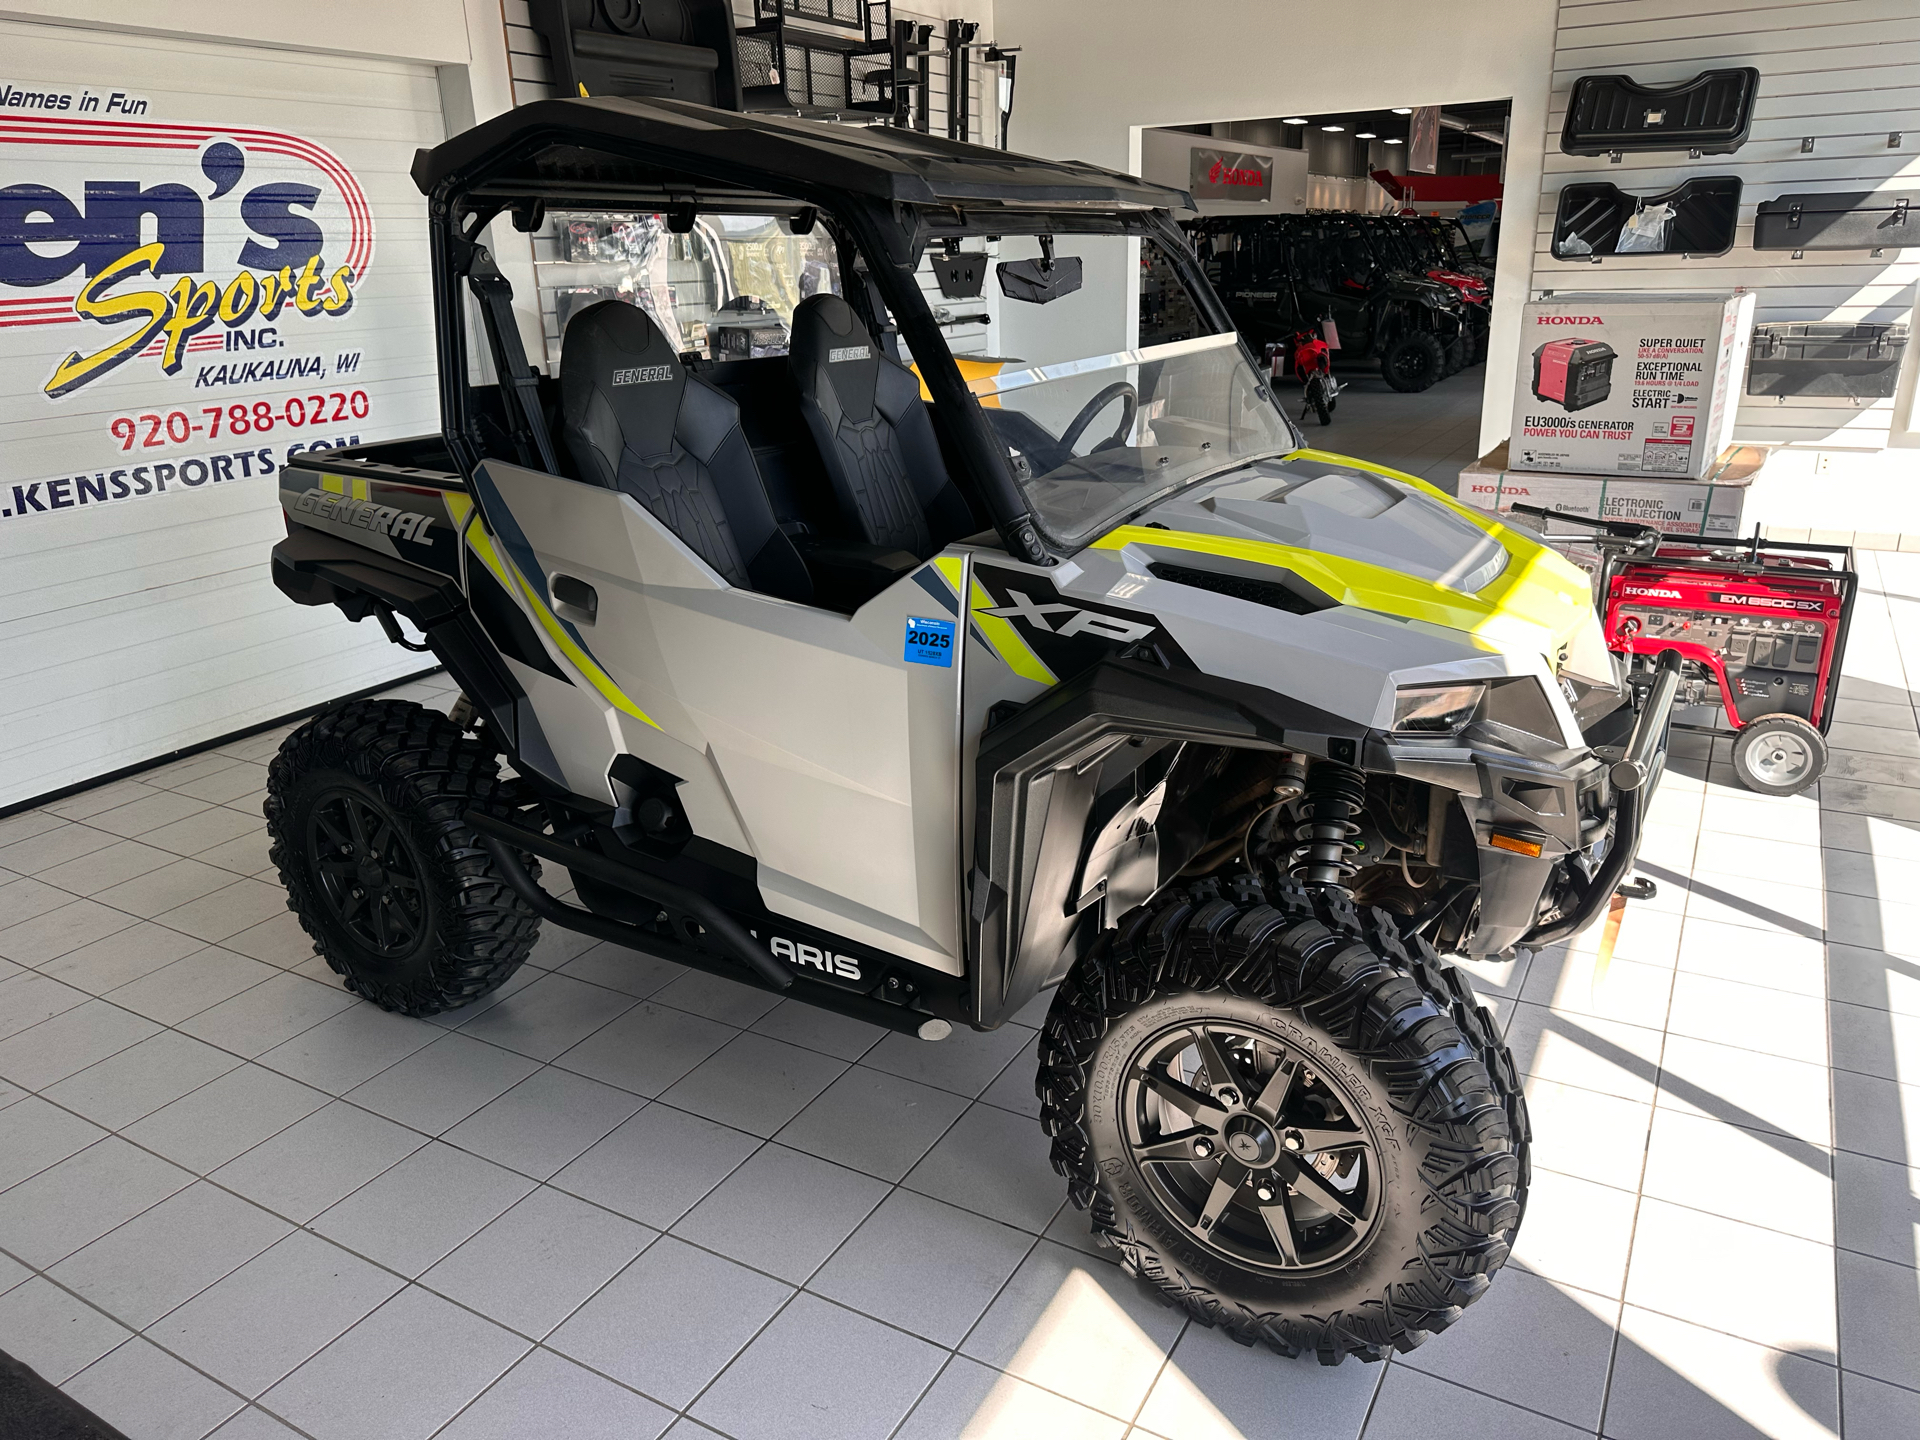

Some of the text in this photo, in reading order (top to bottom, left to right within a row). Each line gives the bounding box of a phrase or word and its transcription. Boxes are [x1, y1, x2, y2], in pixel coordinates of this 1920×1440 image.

[78, 90, 100, 112] in
[105, 92, 148, 115] Fun
[1222, 167, 1264, 187] HONDA
[44, 242, 356, 398] Sports
[1536, 316, 1605, 325] HONDA
[225, 329, 285, 352] INC.
[1639, 338, 1706, 348] SUPER QUIET
[829, 345, 872, 364] GENERAL
[194, 352, 361, 389] KAUKAUNA, WI
[612, 365, 674, 387] GENERAL
[1635, 371, 1685, 381] RUN TIME
[1637, 362, 1703, 371] EXCEPTIONAL
[1633, 389, 1671, 397] ELECTRIC
[1632, 397, 1670, 409] START
[111, 389, 370, 452] 920-788-0220
[1524, 416, 1634, 431] EU3000is GENERATOR
[1523, 428, 1633, 440] POWER YOU CAN TRUST
[1471, 485, 1531, 496] HONDA
[293, 487, 436, 547] GENERAL
[1563, 505, 1588, 513] Bluetooth
[1625, 509, 1681, 521] INJECTION
[1625, 586, 1682, 599] HONDA
[978, 587, 1157, 643] XP
[908, 630, 950, 649] 2025
[751, 930, 862, 981] ARIS
[1271, 1017, 1372, 1101] CRAWLER
